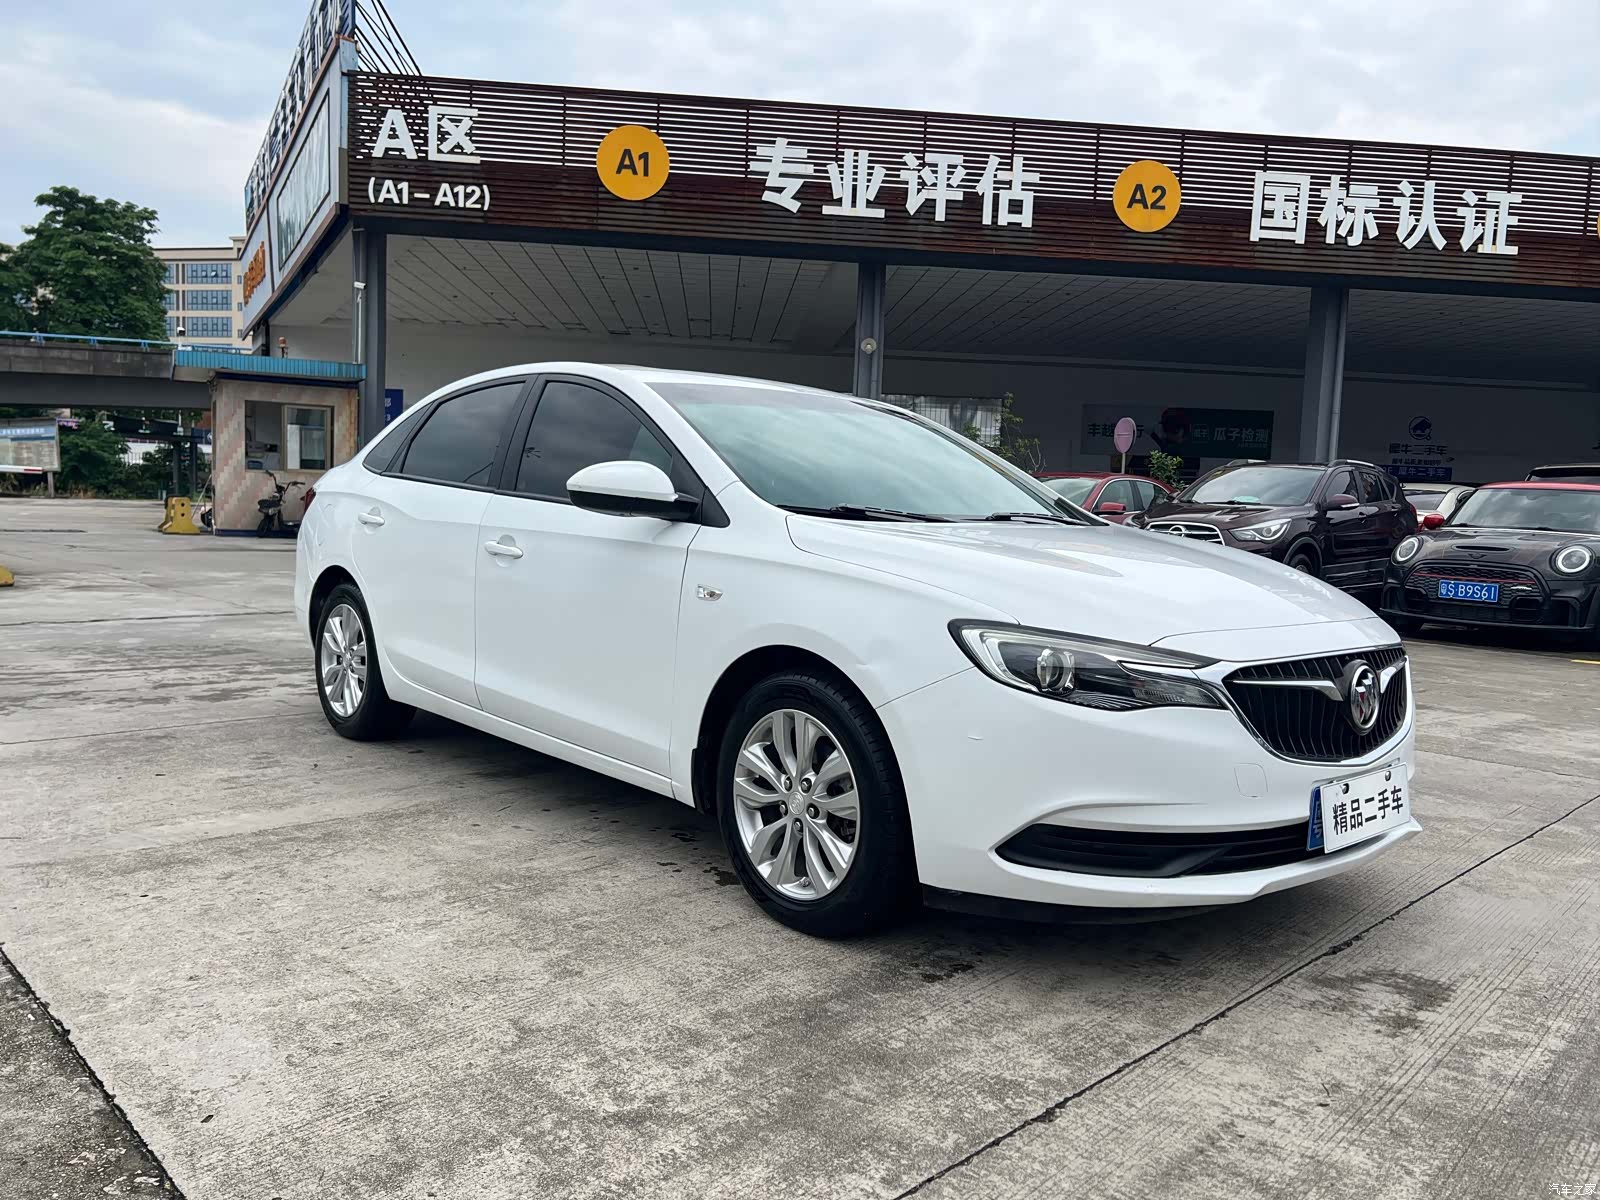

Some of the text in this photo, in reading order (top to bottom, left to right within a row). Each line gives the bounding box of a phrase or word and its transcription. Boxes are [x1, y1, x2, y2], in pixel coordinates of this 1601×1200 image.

[615, 148, 650, 178] A1
[749, 137, 1041, 228] 专业评估
[1126, 183, 1169, 211] A2
[1249, 171, 1523, 256] 国标认证
[1213, 427, 1268, 443] 瓜子检测
[1388, 443, 1448, 456] 犀牛二手车
[1398, 466, 1446, 476] 犀牛二手车
[1332, 785, 1403, 836] 精品二手车
